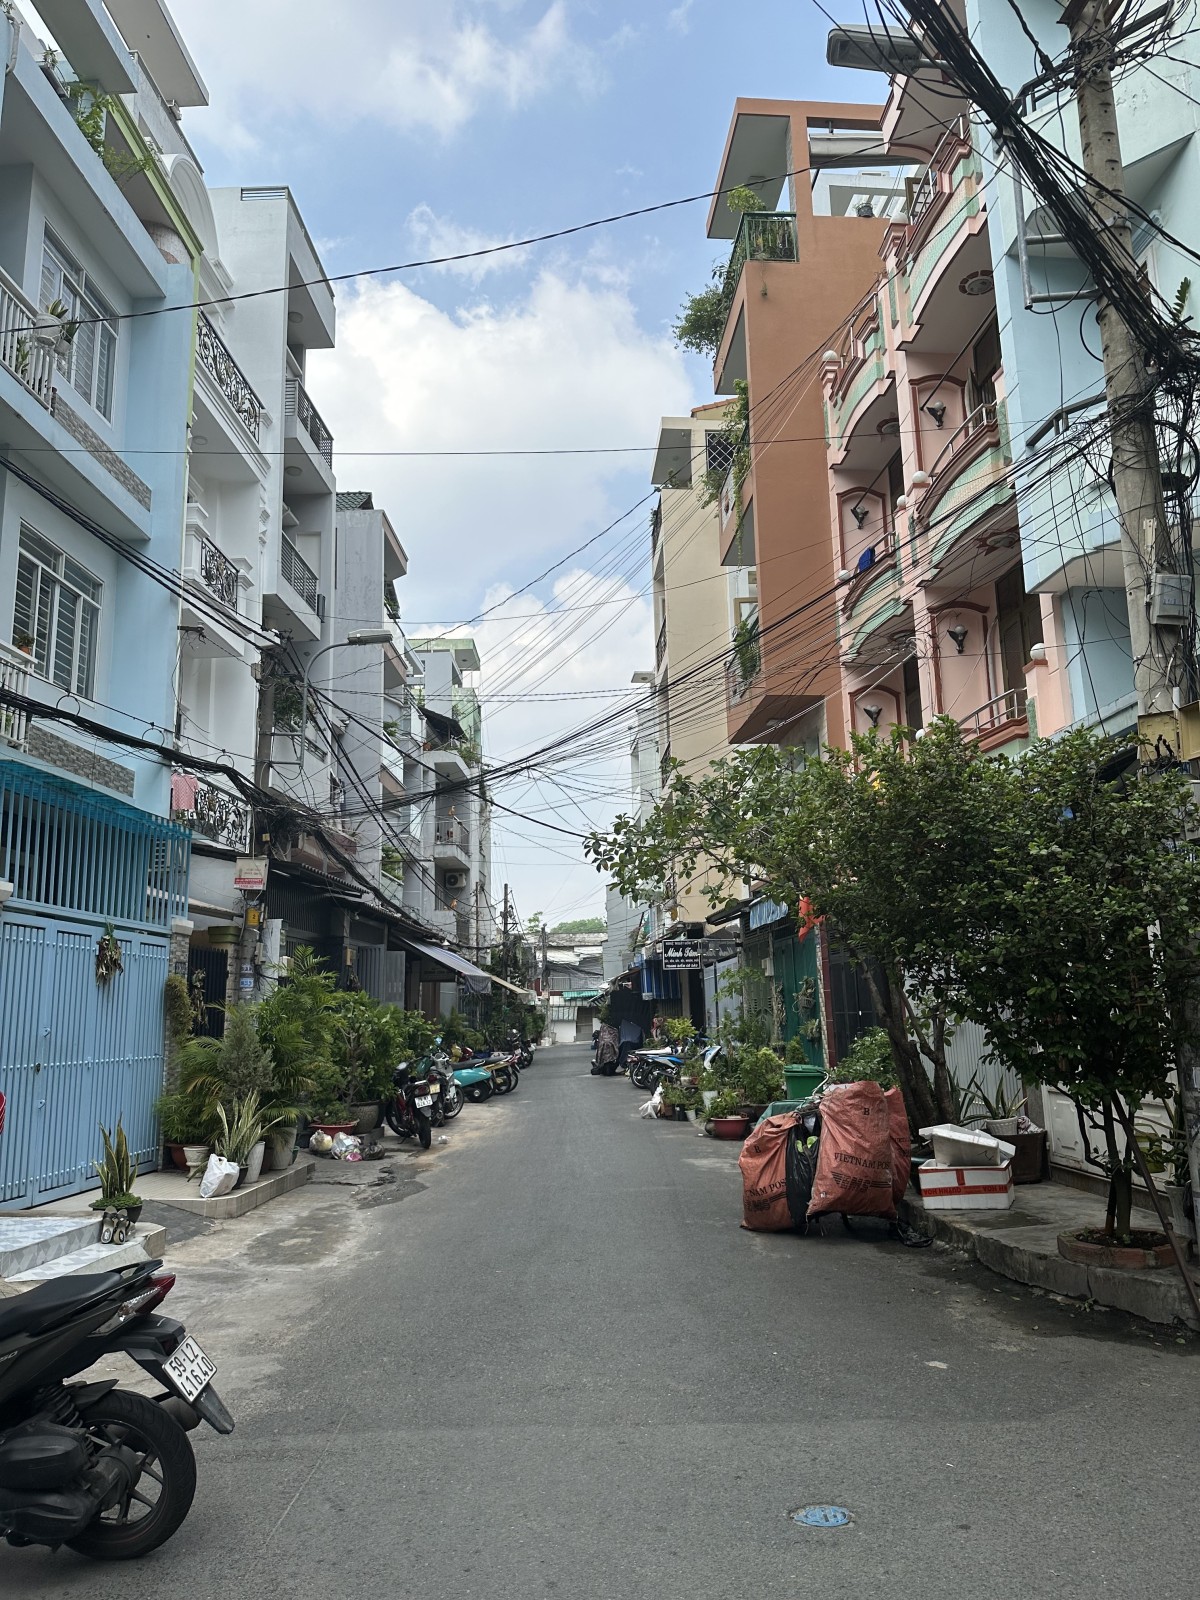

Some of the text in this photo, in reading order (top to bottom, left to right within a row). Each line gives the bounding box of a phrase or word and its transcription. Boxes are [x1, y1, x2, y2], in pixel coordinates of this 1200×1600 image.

[664, 947, 683, 958] Minh
[863, 1107, 870, 1116] B
[834, 1152, 891, 1170] VIETNAM POS
[768, 1177, 787, 1192] POS
[180, 1355, 214, 1397] 416.40
